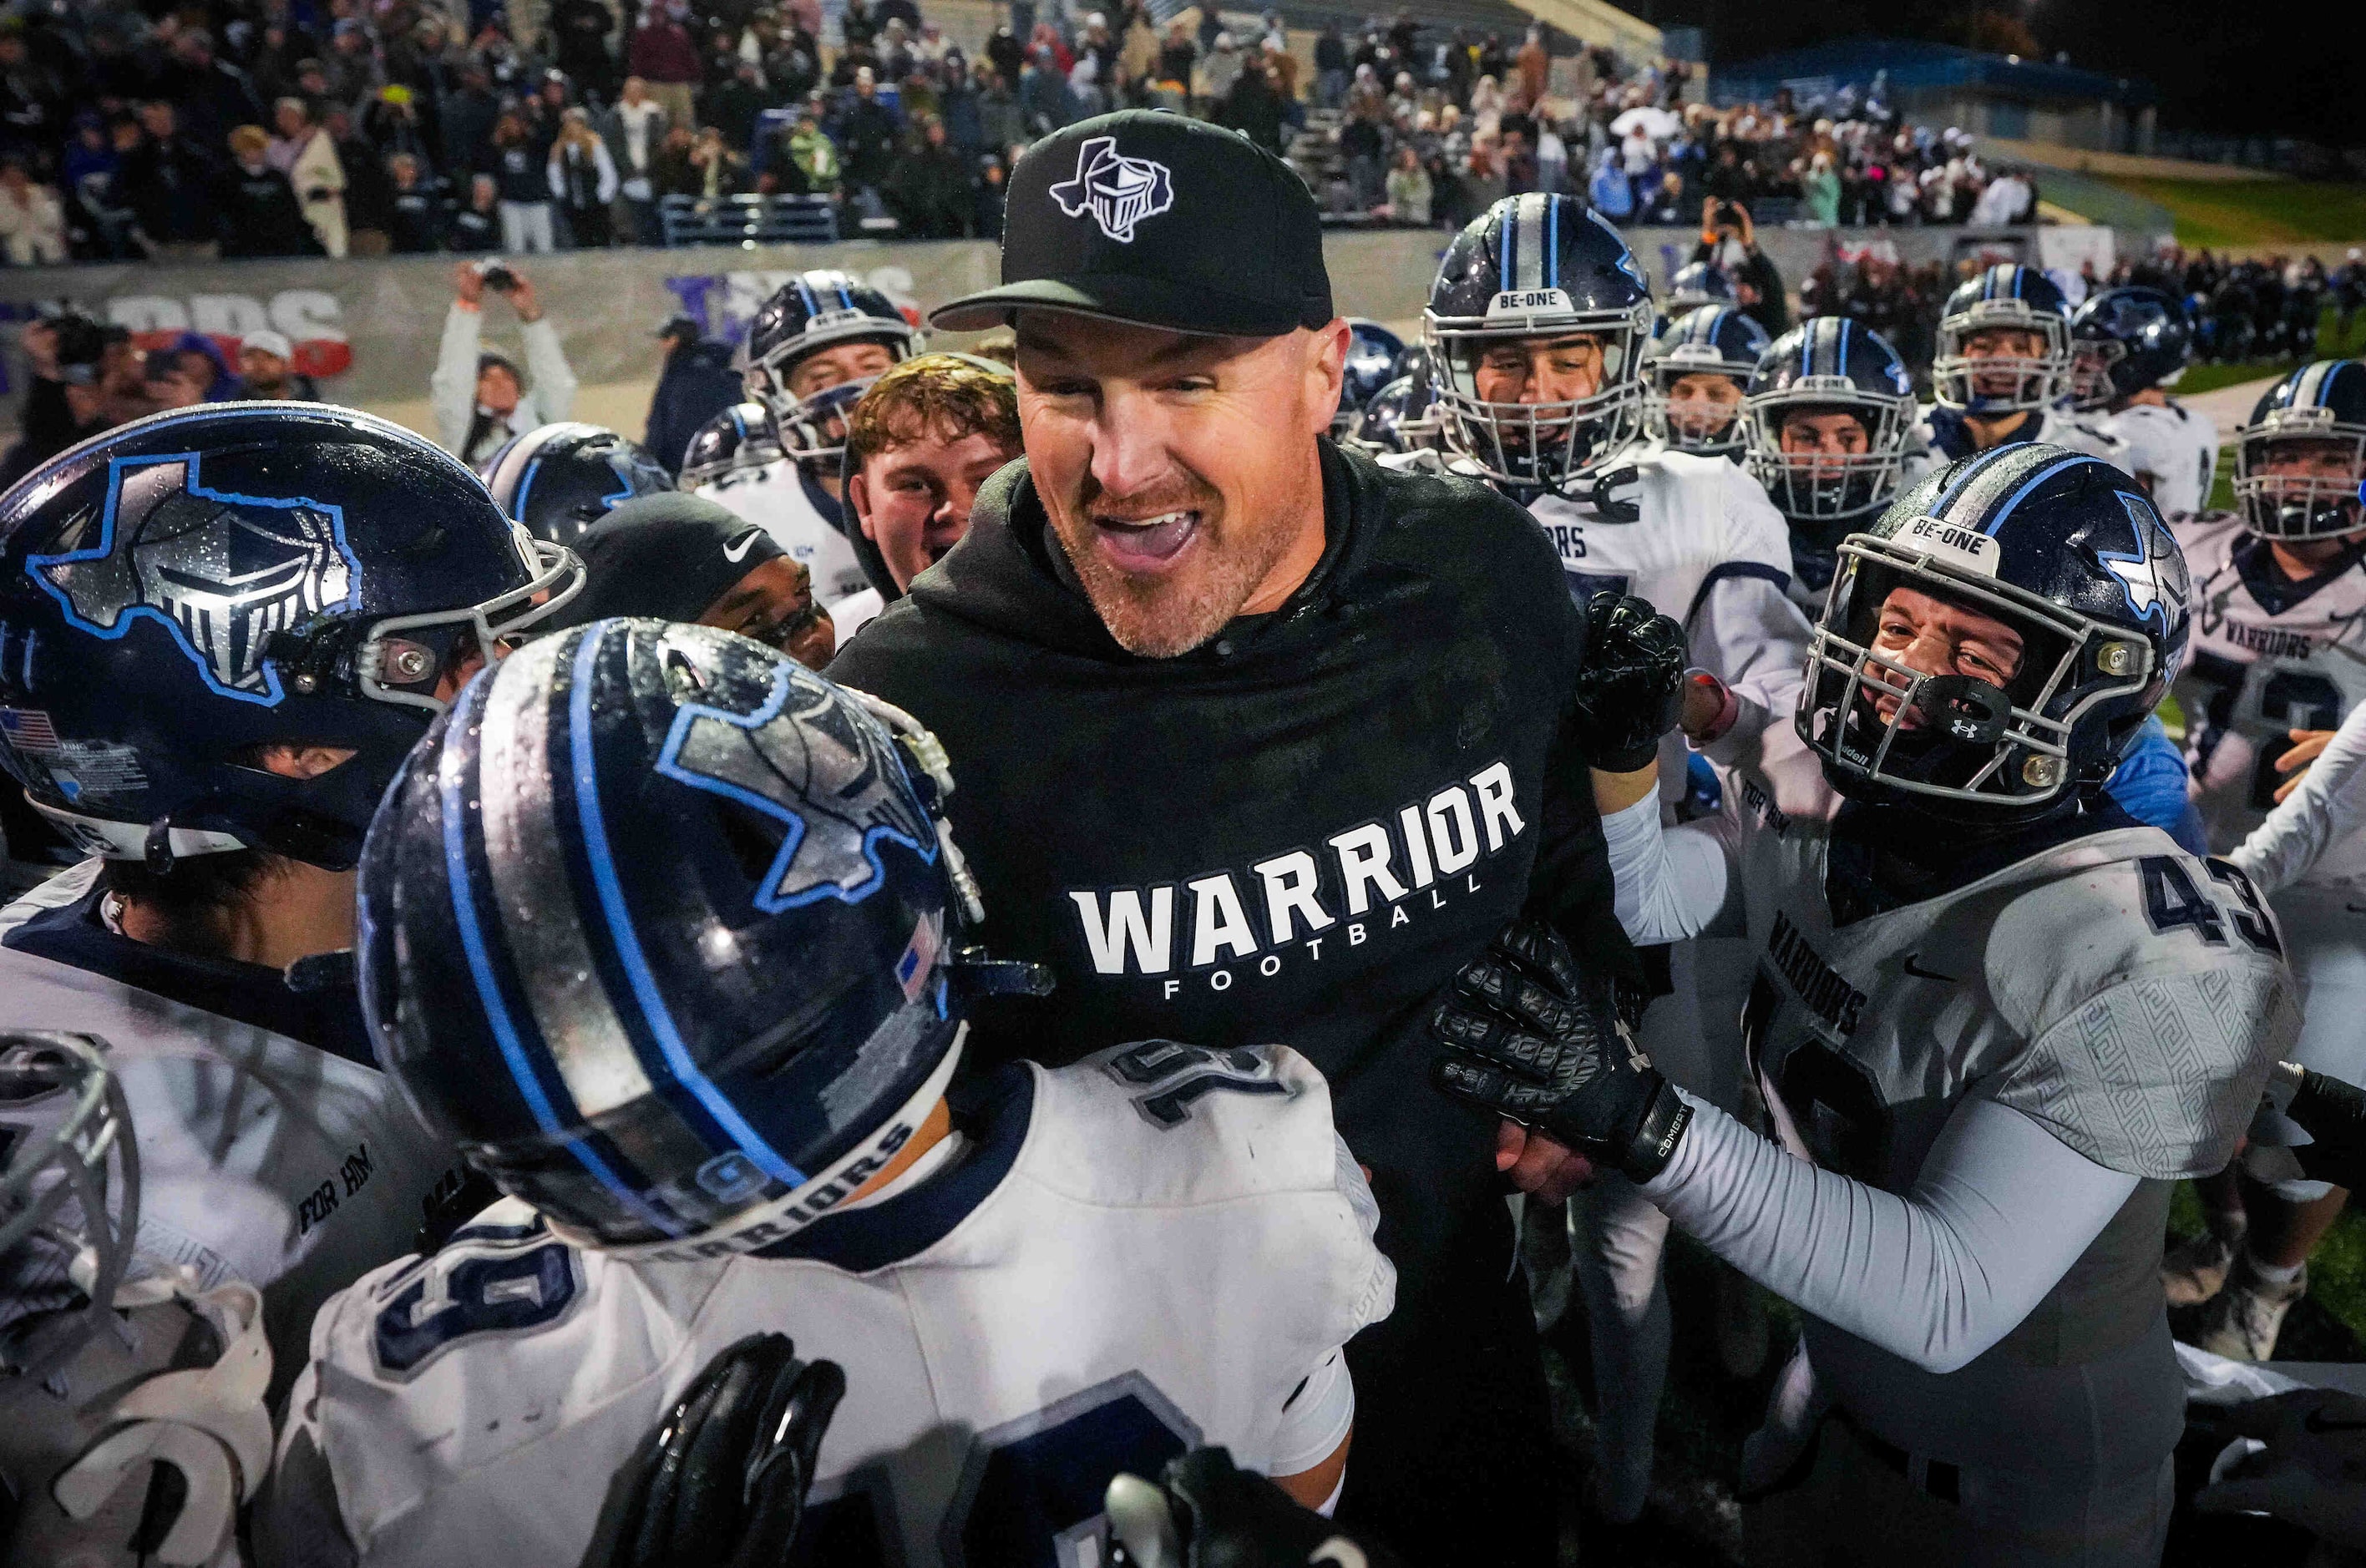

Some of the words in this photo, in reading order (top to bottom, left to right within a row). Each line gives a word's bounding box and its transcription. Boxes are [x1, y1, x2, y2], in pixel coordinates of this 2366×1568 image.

[1499, 291, 1558, 309] BE-ONE
[1912, 518, 1988, 555] BE-ONE
[2226, 618, 2312, 660] WARRIORS
[1841, 745, 1869, 766] ddell
[1068, 761, 1526, 975] WARRIOR
[2132, 854, 2284, 963] 43
[1163, 874, 1482, 1000] FOOTBALL
[1767, 908, 1869, 1037] WARRIORS
[1658, 1105, 1689, 1158] COMBAT
[298, 1180, 339, 1234] FOR
[651, 1123, 914, 1262] ARRIORS
